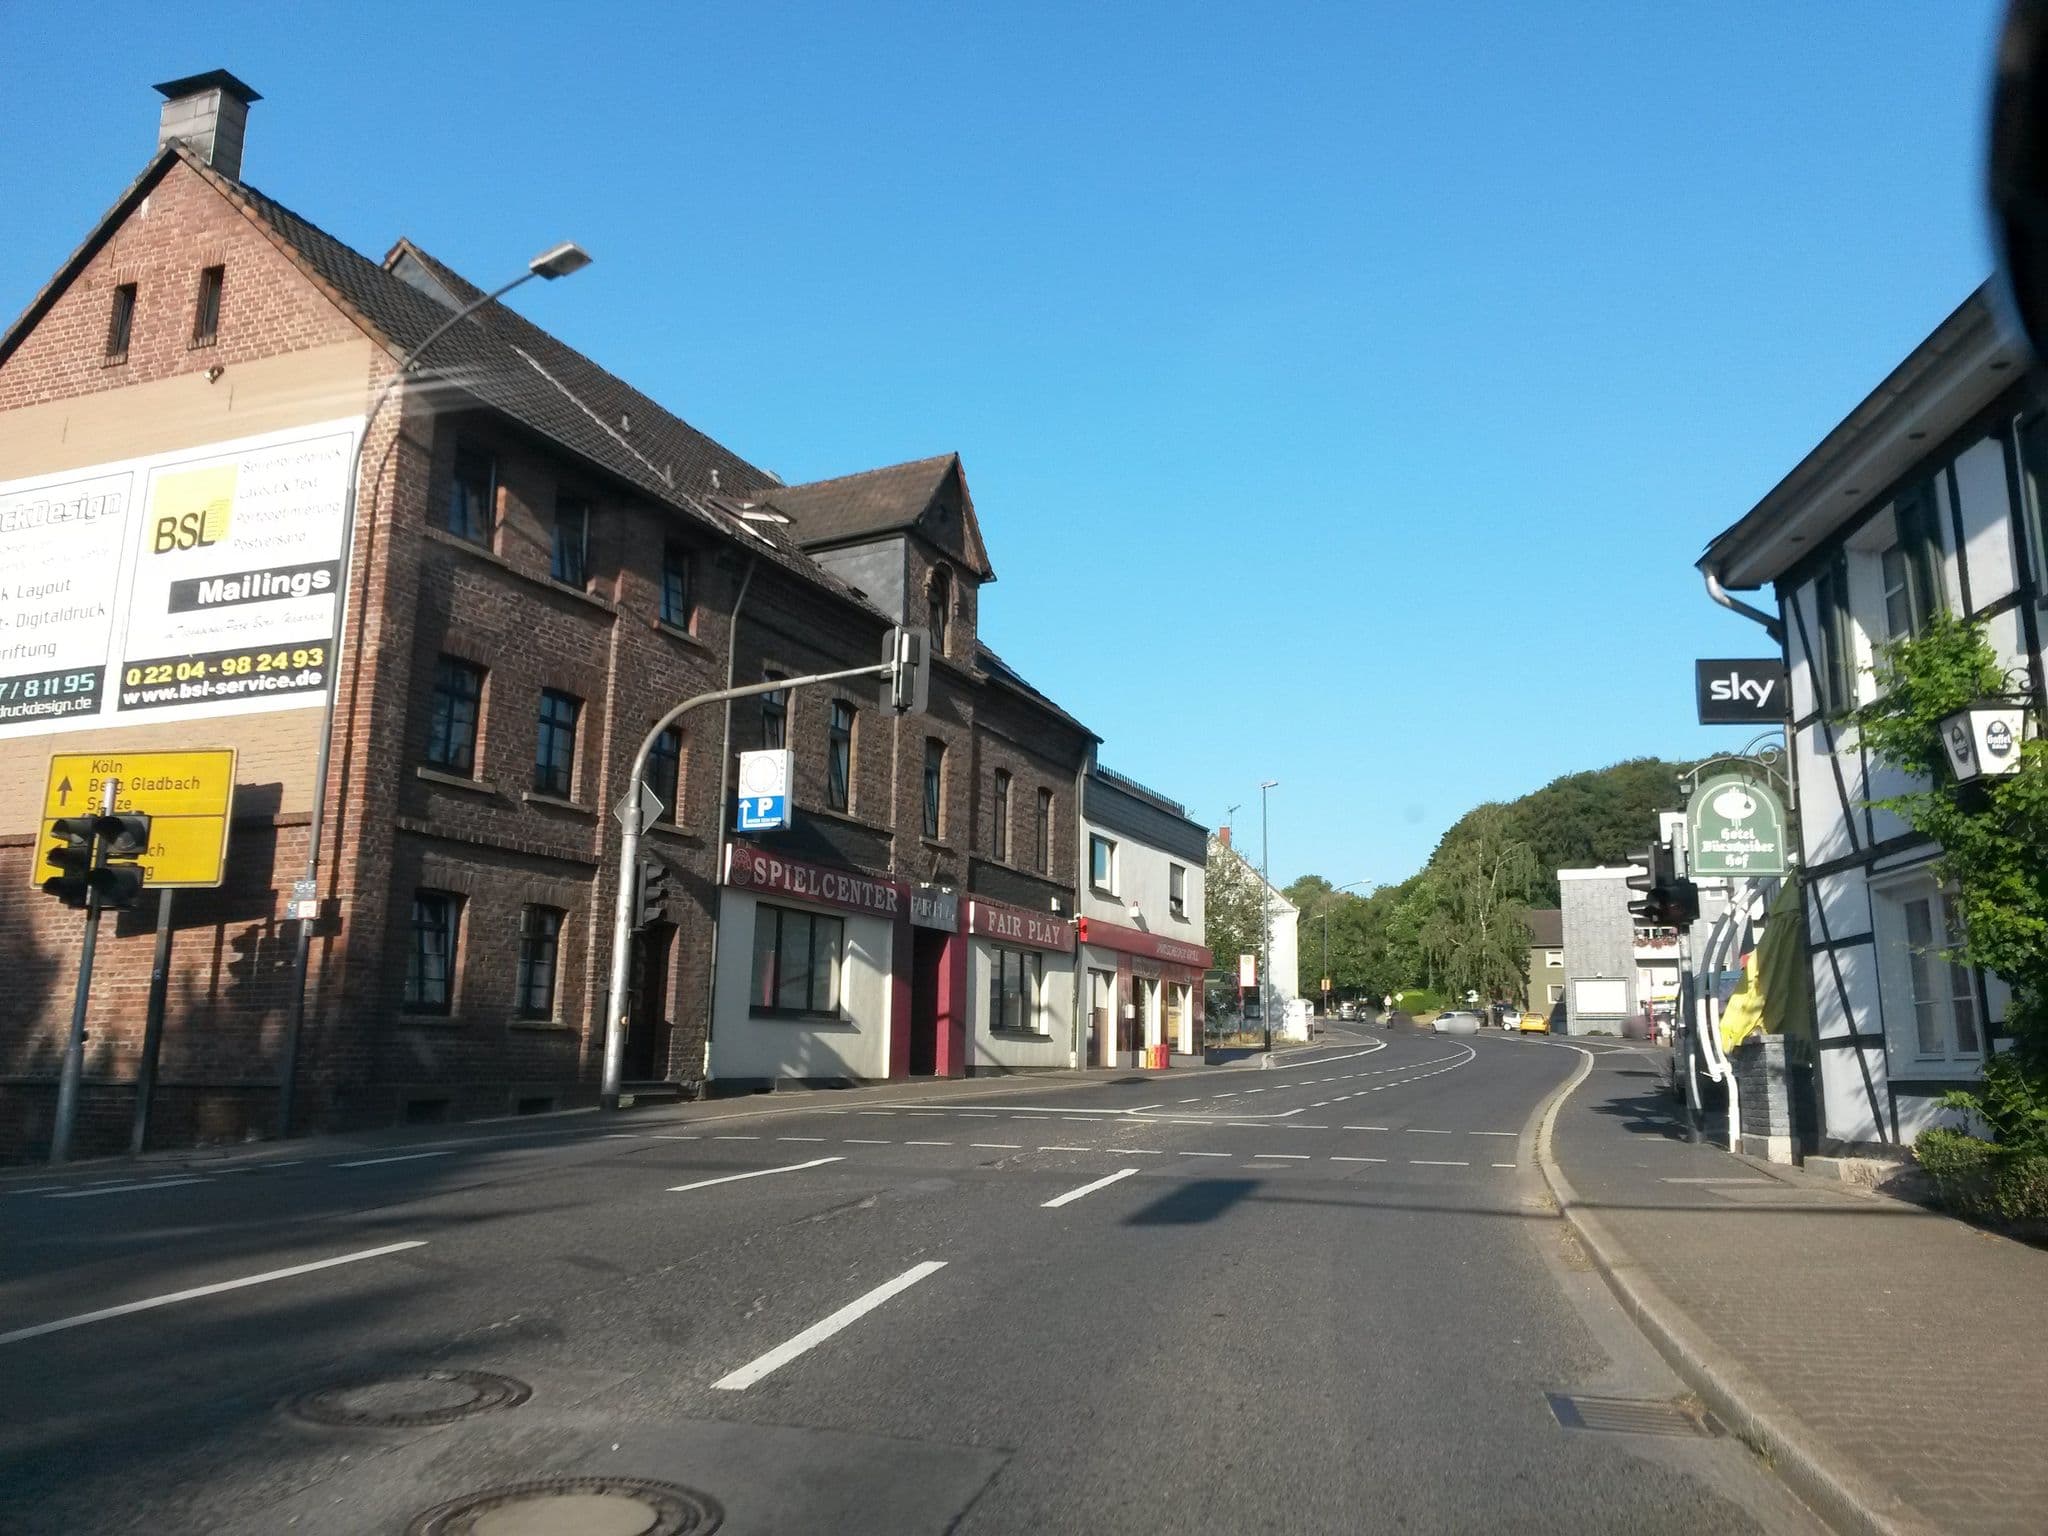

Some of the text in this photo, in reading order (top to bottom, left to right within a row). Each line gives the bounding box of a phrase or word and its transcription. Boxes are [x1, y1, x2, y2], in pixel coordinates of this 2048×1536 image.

[154, 510, 216, 555] BSL
[17, 579, 71, 600] Layout
[197, 568, 331, 604] Mailings
[16, 602, 105, 630] Digitaldruck
[123, 669, 322, 704] www.bsl-service.de
[1710, 672, 1775, 708] sky
[91, 759, 123, 774] Köln
[89, 776, 200, 795] Beg. Gladbach
[87, 797, 132, 813] Spze
[757, 797, 773, 817] P
[1720, 827, 1756, 842] Hotel
[1725, 853, 1750, 869] Hof
[753, 857, 898, 912] SPIELCENTER
[988, 910, 1060, 944] FAIR PLAY
